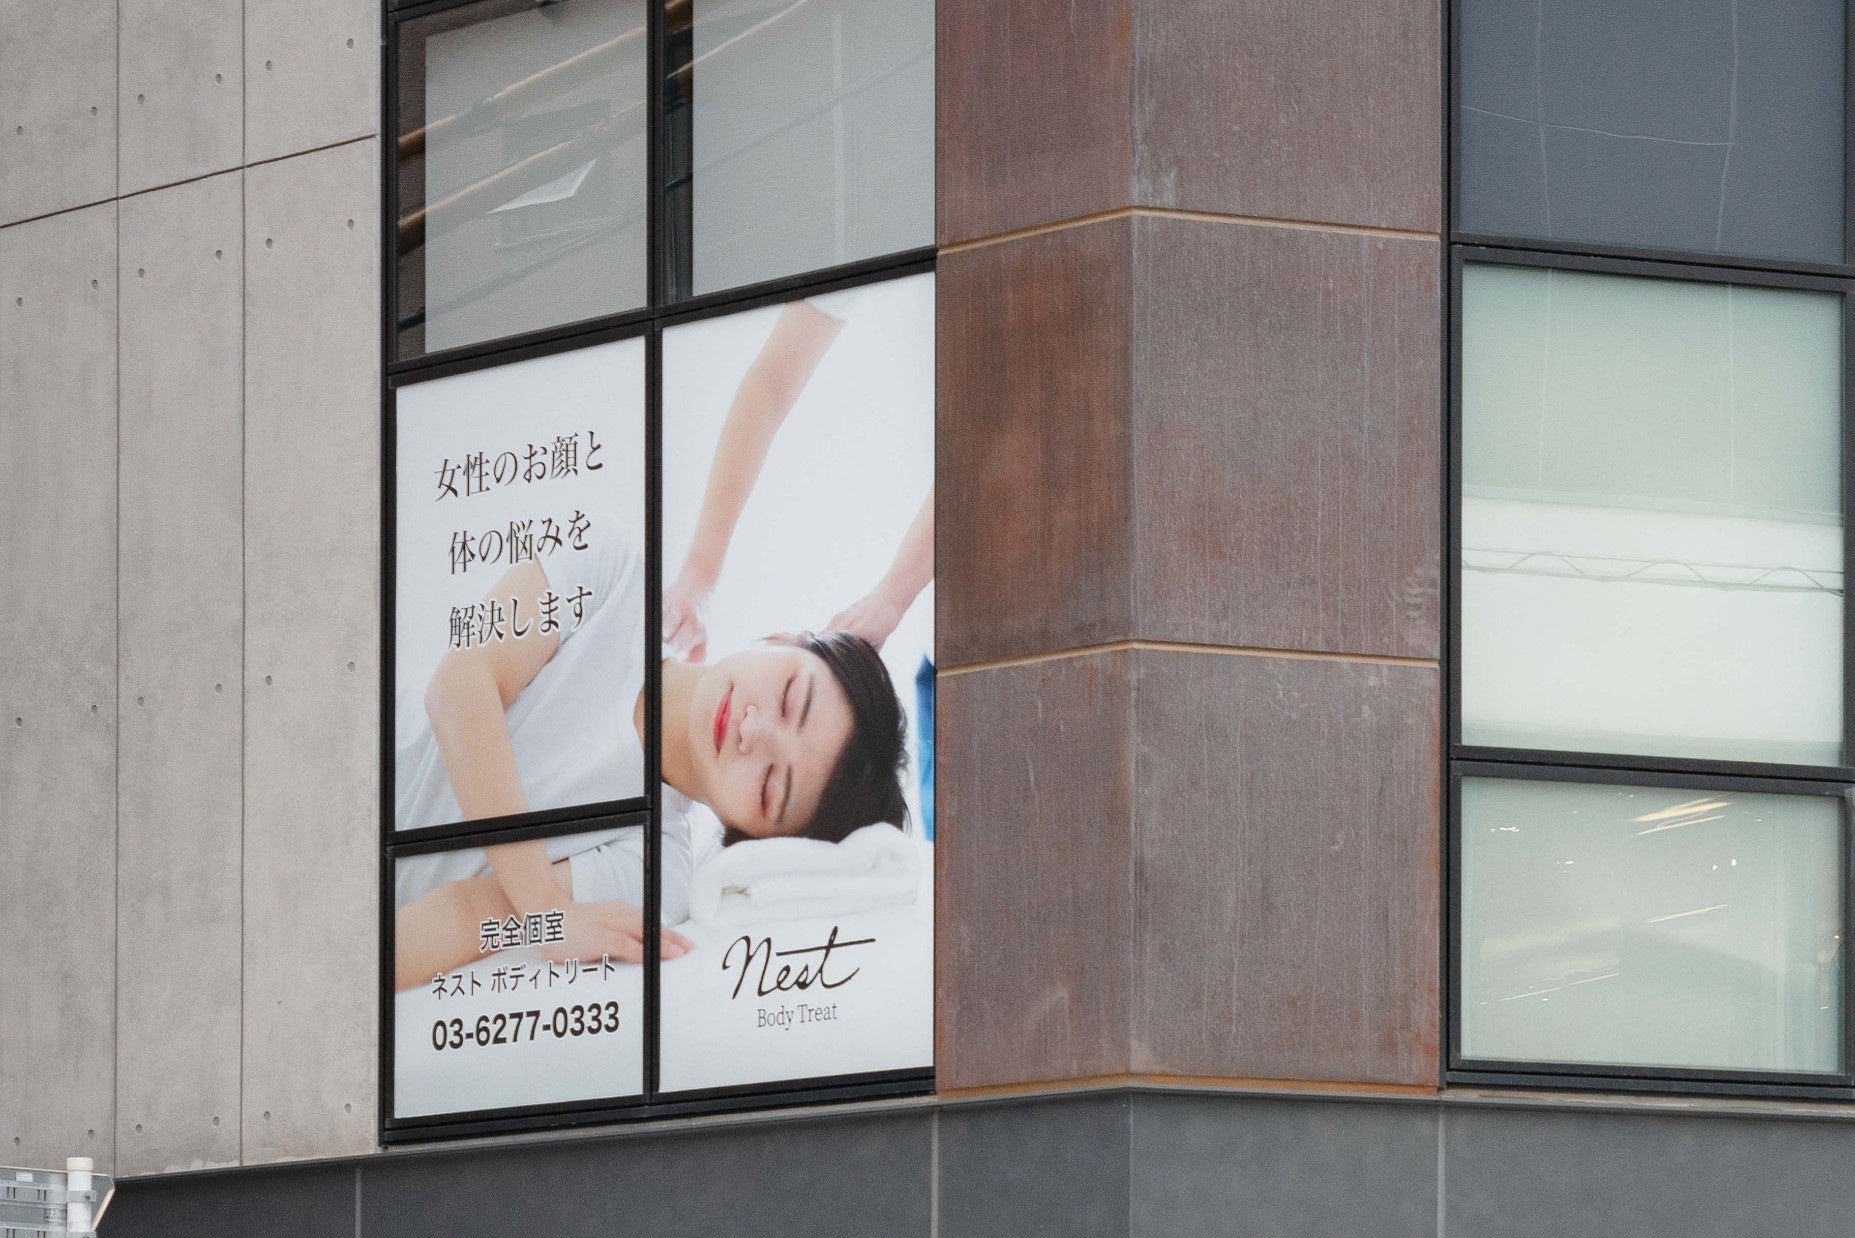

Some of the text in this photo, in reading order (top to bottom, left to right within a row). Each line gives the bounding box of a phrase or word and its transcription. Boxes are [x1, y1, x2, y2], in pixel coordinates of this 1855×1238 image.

[434, 431, 603, 502] 女性のお顔と
[448, 510, 592, 575] 体の悩みを
[448, 586, 593, 649] 解決します
[479, 910, 565, 952] 完全個室
[431, 954, 616, 1000] ネスト ボディトリート
[721, 925, 876, 1000] Nest
[431, 1000, 621, 1051] 03-6277-0333
[757, 1002, 838, 1031] Body Treat
